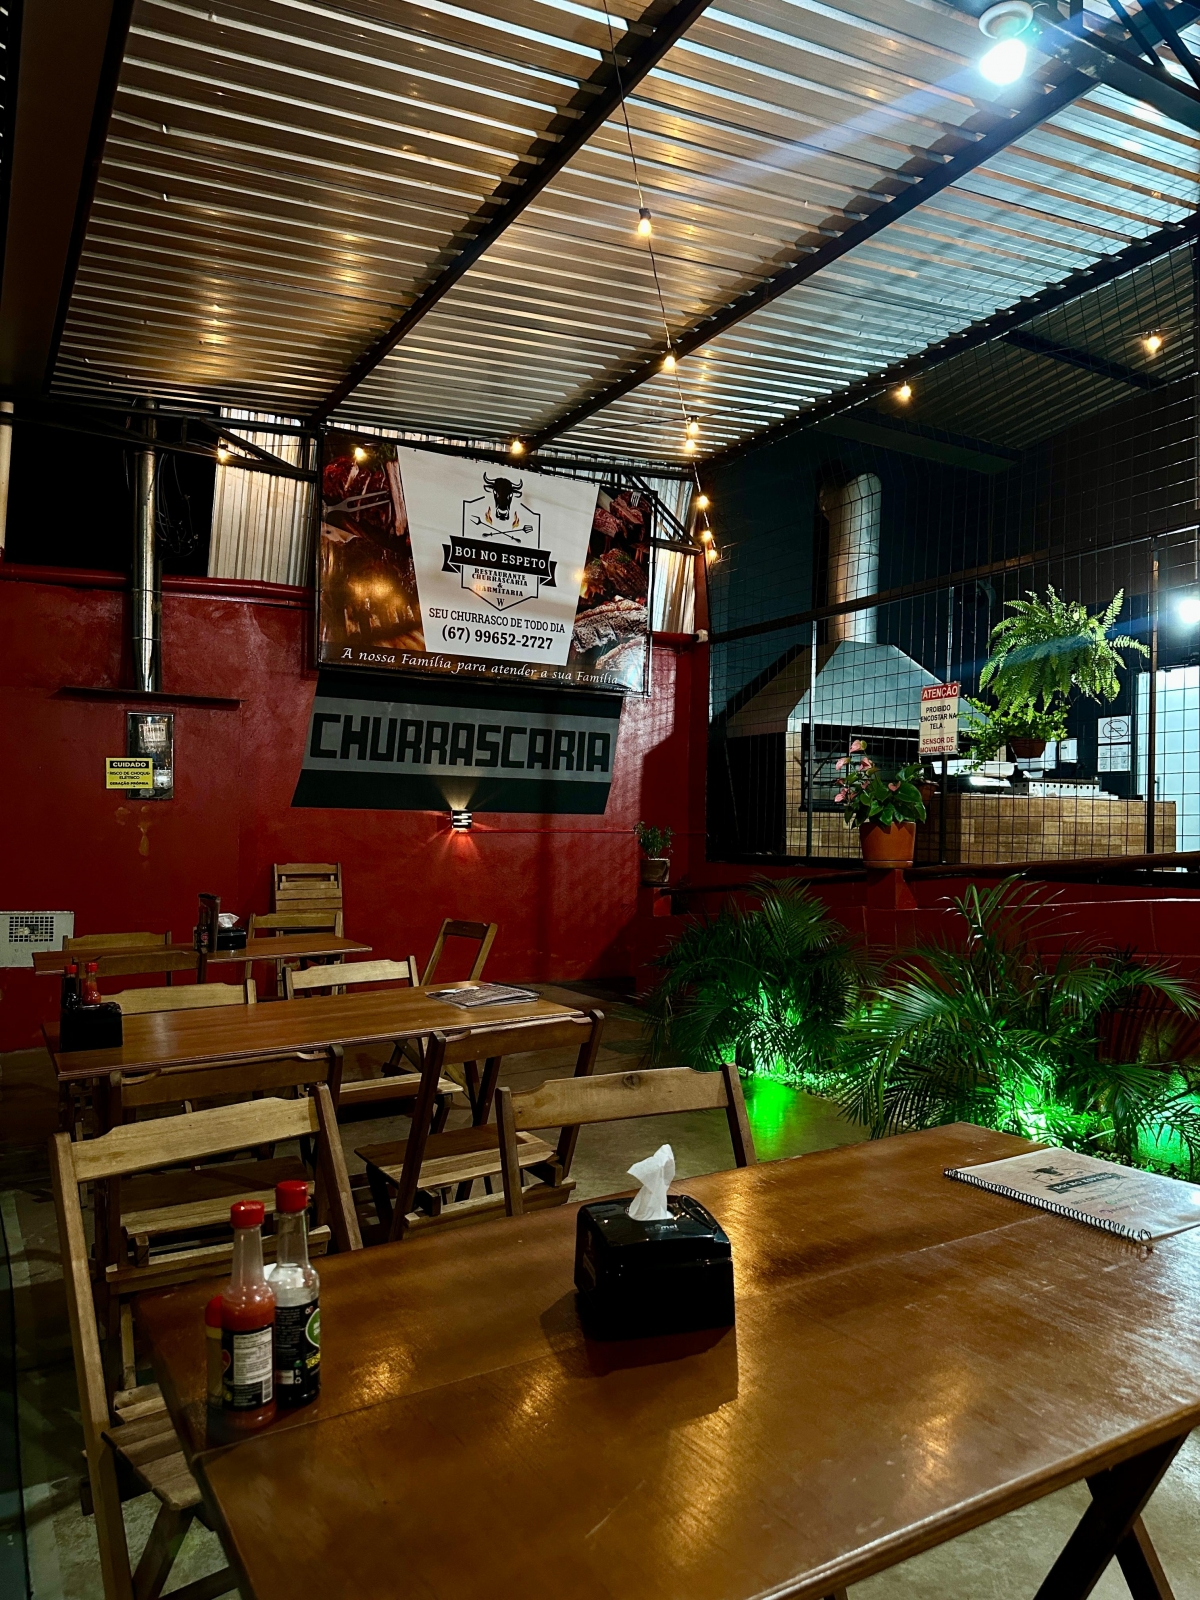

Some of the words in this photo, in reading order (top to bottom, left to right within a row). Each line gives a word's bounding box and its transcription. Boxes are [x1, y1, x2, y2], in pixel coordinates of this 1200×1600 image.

[455, 546, 476, 559] BOI
[480, 550, 497, 562] NO
[502, 553, 546, 569] ESPETO
[472, 574, 528, 586] CHURRASCARIA
[474, 568, 526, 580] RESTAURANTE
[497, 598, 505, 607] W
[429, 608, 449, 619] SEU
[450, 610, 508, 626] CHURRASCO
[510, 618, 523, 628] DE
[524, 620, 548, 632] TODO
[550, 622, 566, 634] DIA
[442, 624, 471, 644] (67)
[474, 629, 553, 650] 99652-2727
[341, 647, 353, 659] A
[358, 652, 396, 664] nossa
[401, 653, 452, 669] Família
[450, 662, 487, 674] para
[491, 664, 538, 677] atender
[540, 670, 548, 678] a
[552, 671, 572, 680] sua
[576, 671, 618, 684] Família
[922, 684, 958, 700] ATENÇÃO
[926, 704, 951, 713] PROIBIDO
[920, 713, 948, 722] ENCOSTAR
[948, 712, 957, 720] NA
[310, 712, 611, 772] CHURRASCARIA
[922, 737, 946, 746] SENSOR
[920, 744, 954, 753] MOVIMENTO
